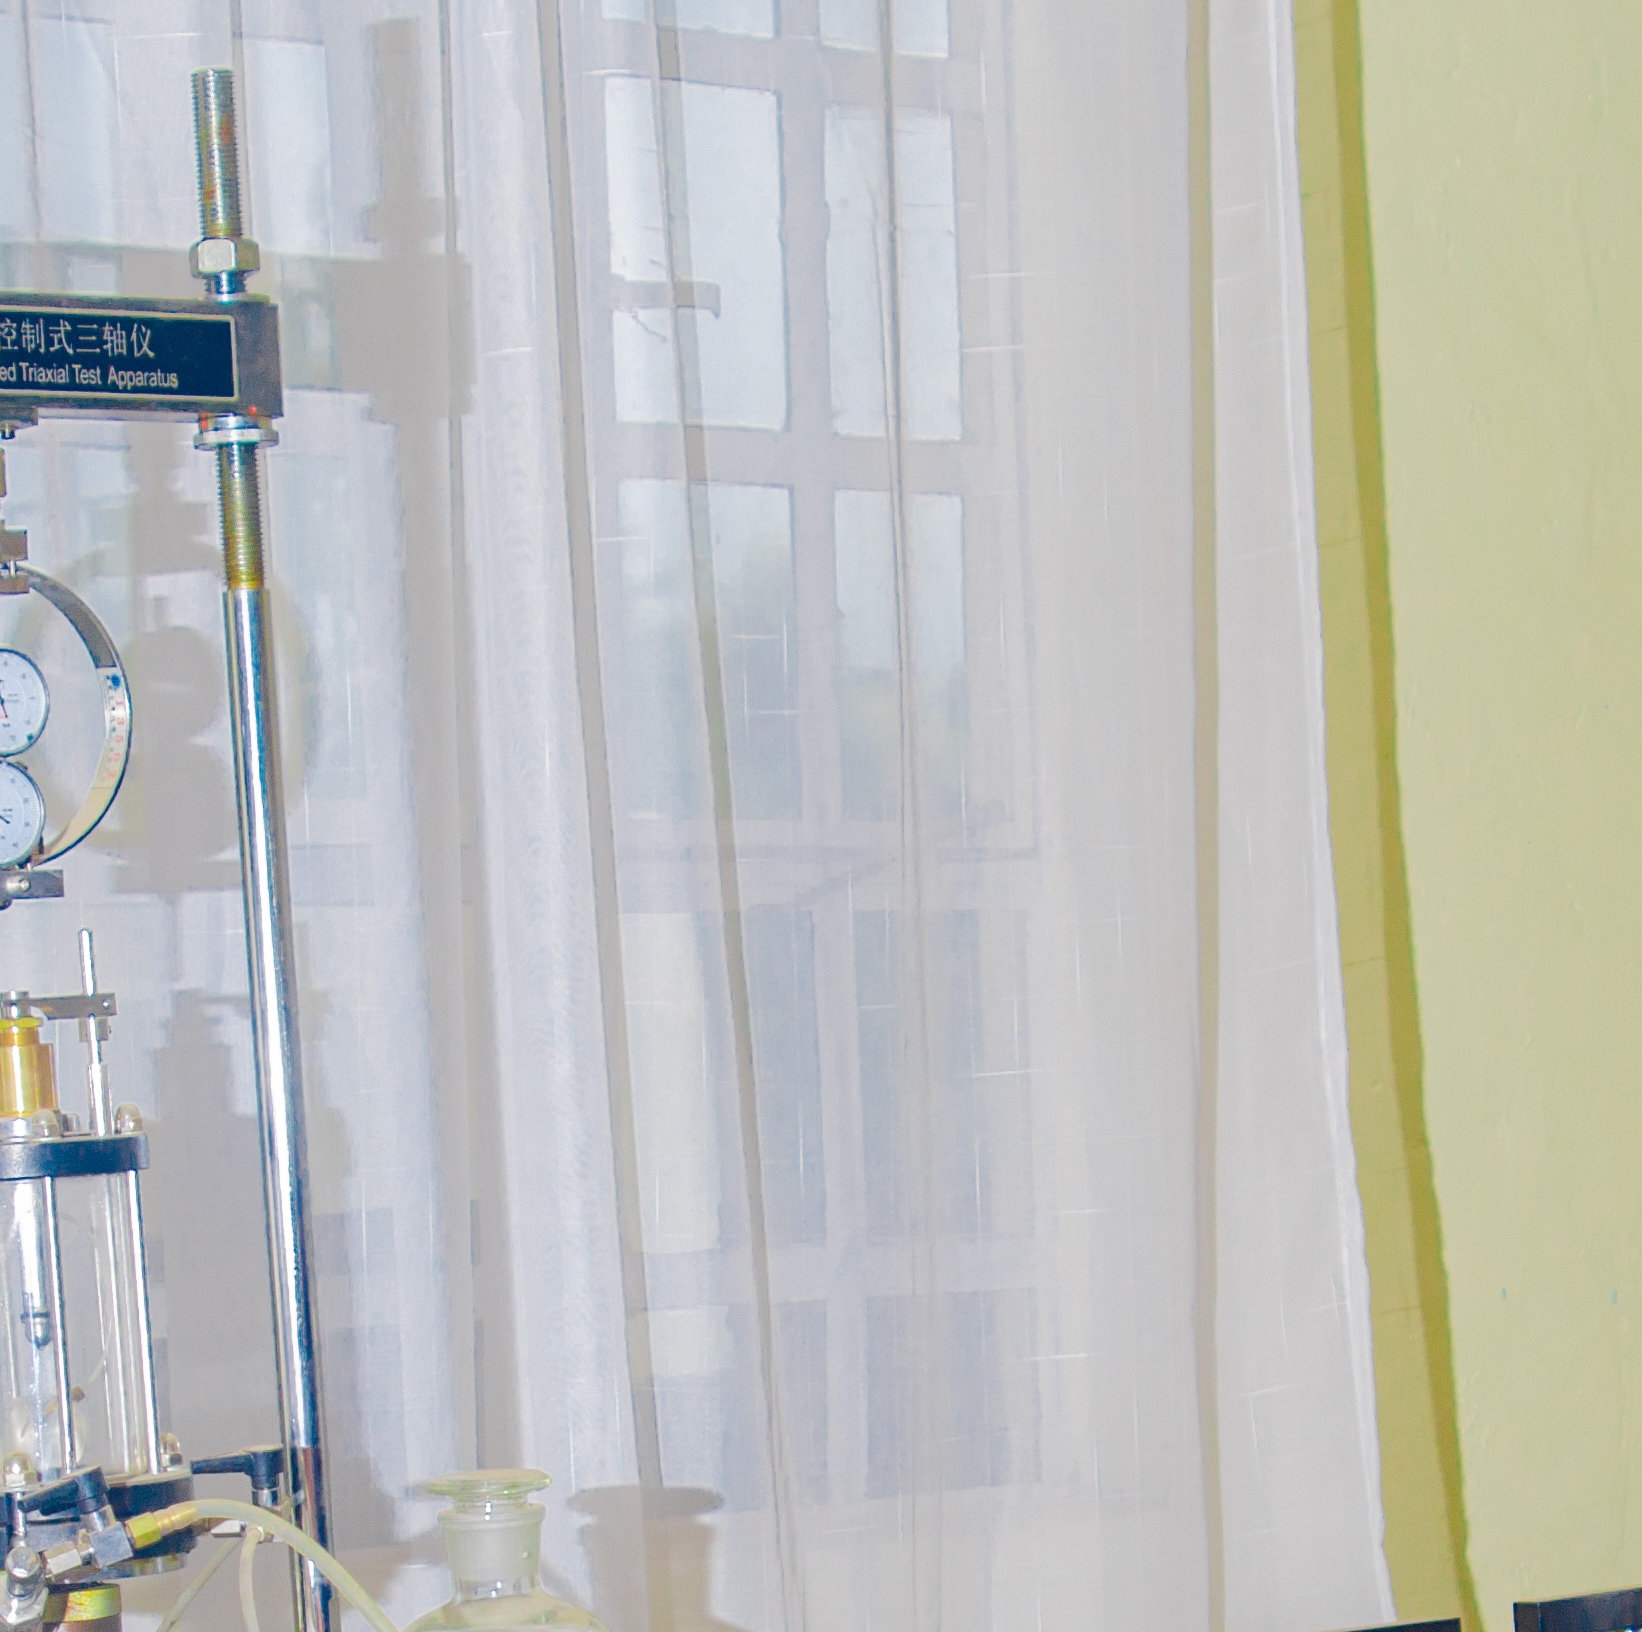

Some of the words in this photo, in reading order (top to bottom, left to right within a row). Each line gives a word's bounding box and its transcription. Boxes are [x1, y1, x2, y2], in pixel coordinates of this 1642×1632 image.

[19, 361, 69, 385] Triaxial
[73, 363, 101, 386] Test
[107, 364, 179, 390] Apparatus
